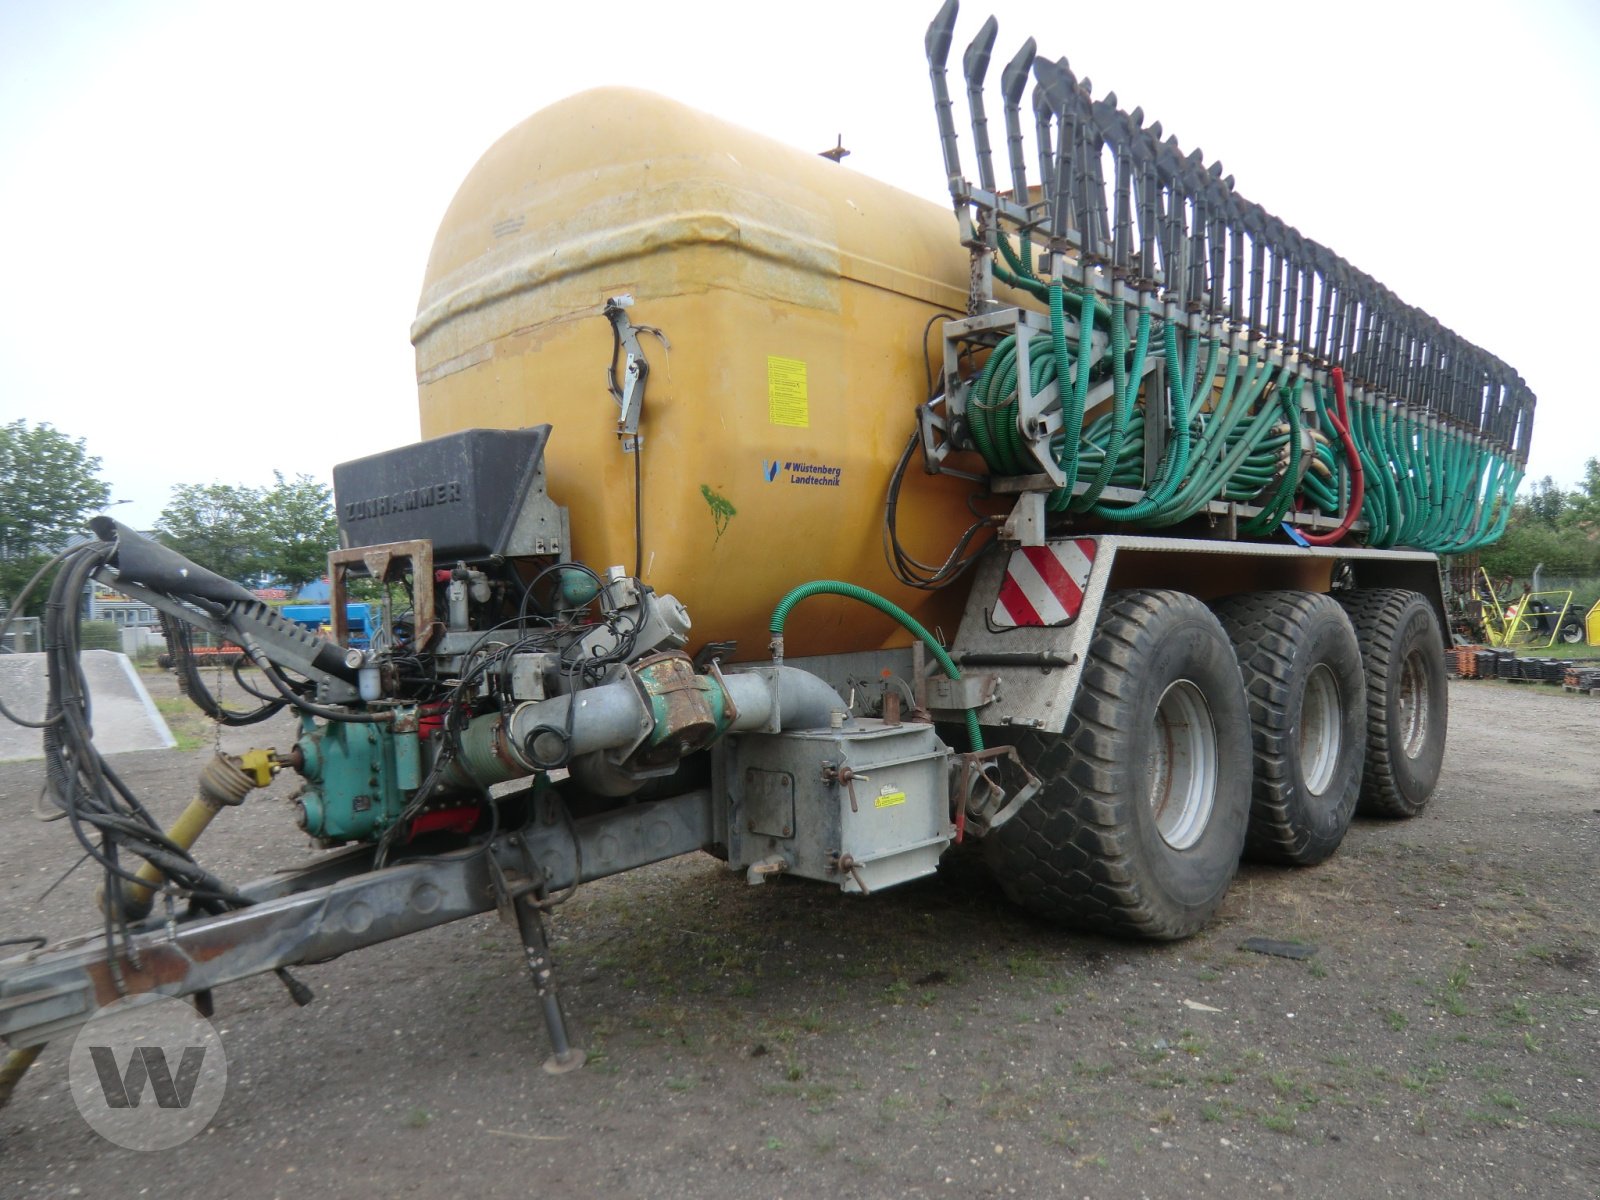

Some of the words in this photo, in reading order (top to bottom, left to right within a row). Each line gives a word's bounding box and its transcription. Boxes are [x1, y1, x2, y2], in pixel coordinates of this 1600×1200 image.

[792, 462, 841, 477] Wüstenberg
[790, 474, 840, 486] Landtechnik
[345, 480, 461, 522] ZUNHAMMER
